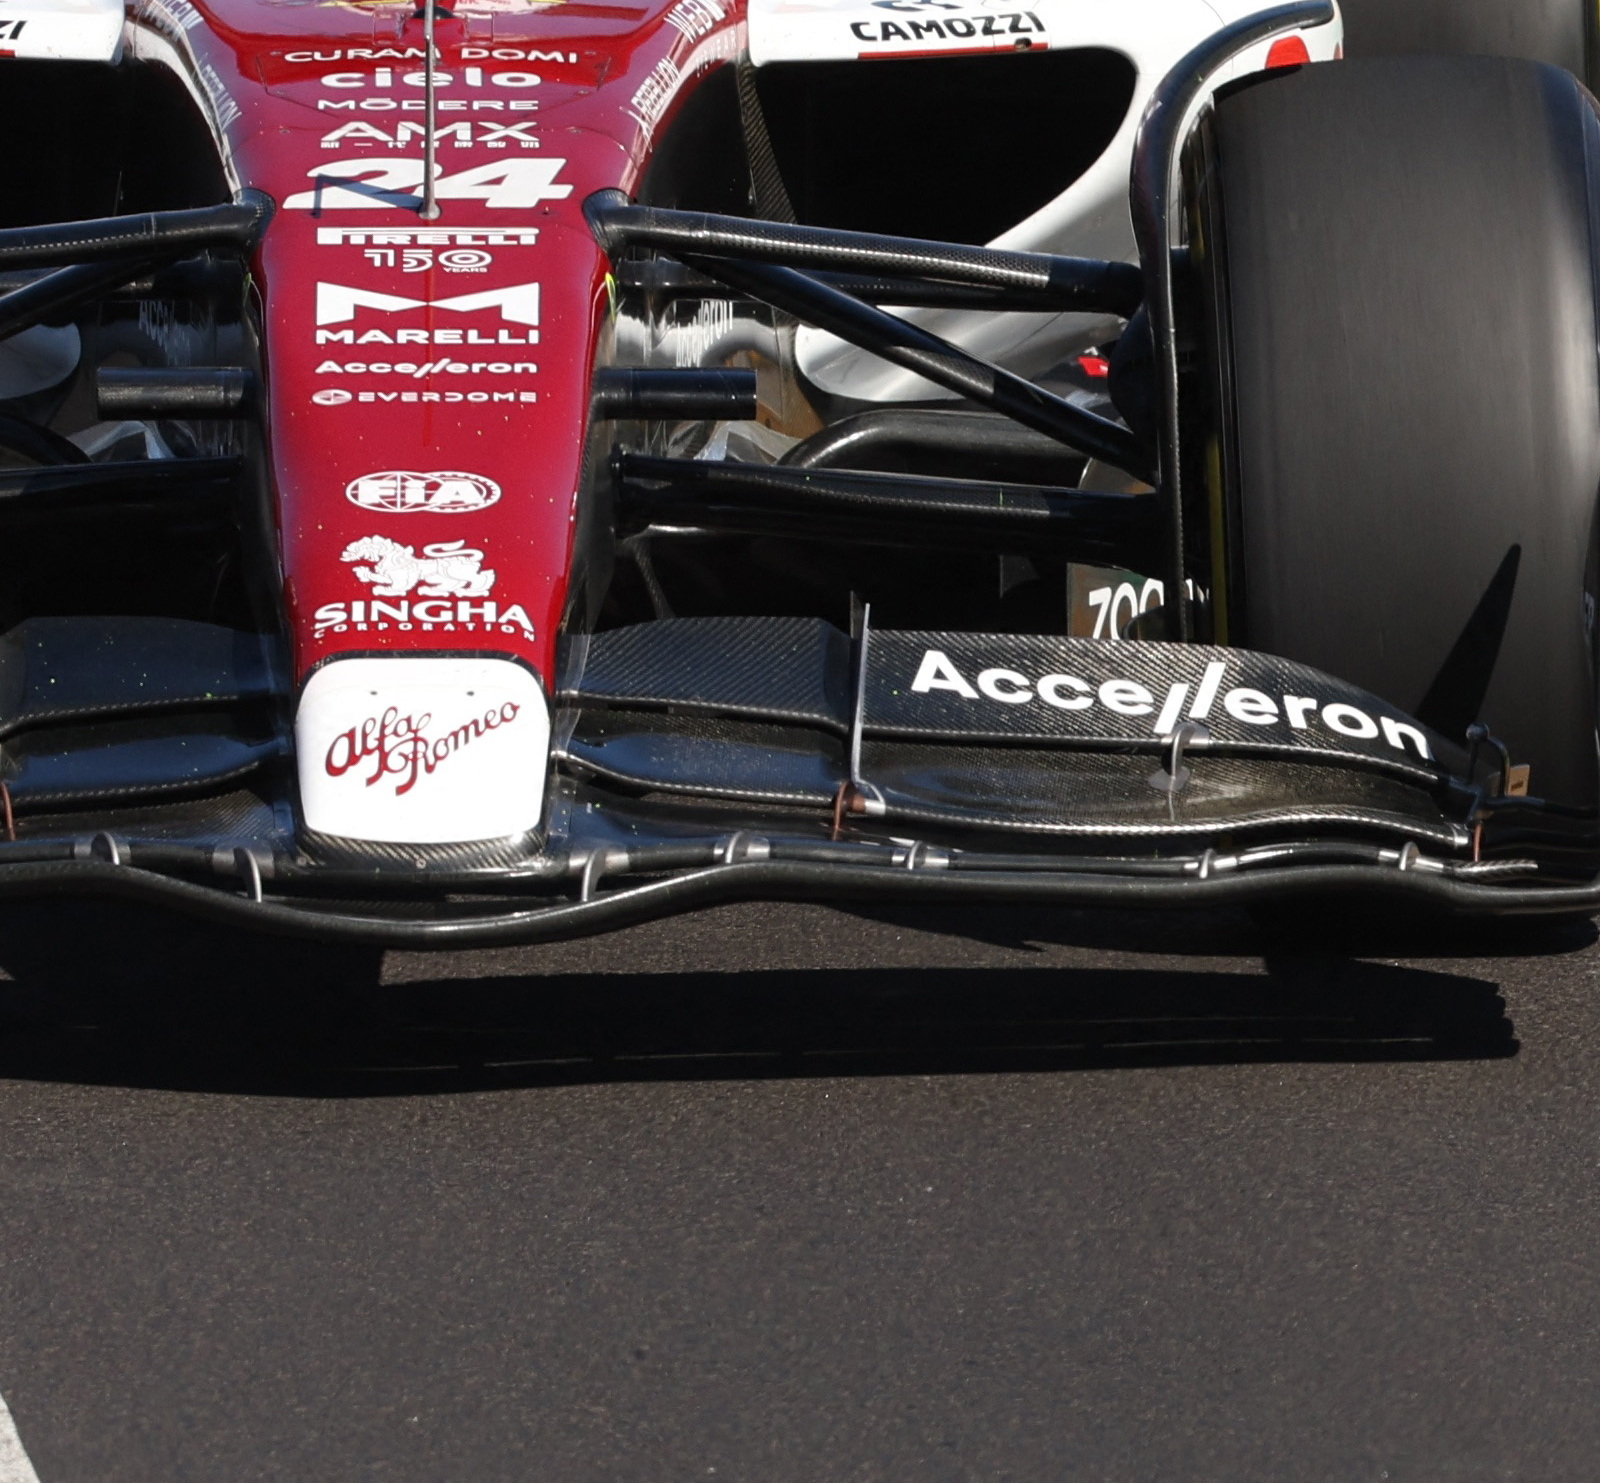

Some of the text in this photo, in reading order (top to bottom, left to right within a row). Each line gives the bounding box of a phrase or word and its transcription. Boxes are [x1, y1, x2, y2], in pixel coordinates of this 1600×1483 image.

[851, 12, 1045, 41] CAMOZZI
[284, 47, 578, 64] CURAM DOMI
[320, 67, 542, 88] cielo
[321, 122, 539, 141] AMX
[283, 158, 574, 208] 24
[316, 226, 540, 246] PIRELLI
[363, 248, 493, 273] 150
[315, 328, 540, 345] MARELLI
[314, 358, 538, 378] Accelleron
[357, 391, 538, 403] EVERDOME
[314, 600, 535, 632] SINGHA
[313, 622, 536, 642] CORPORATION
[911, 650, 1430, 762] Accelleron
[325, 702, 520, 796] Alfa Romeo
